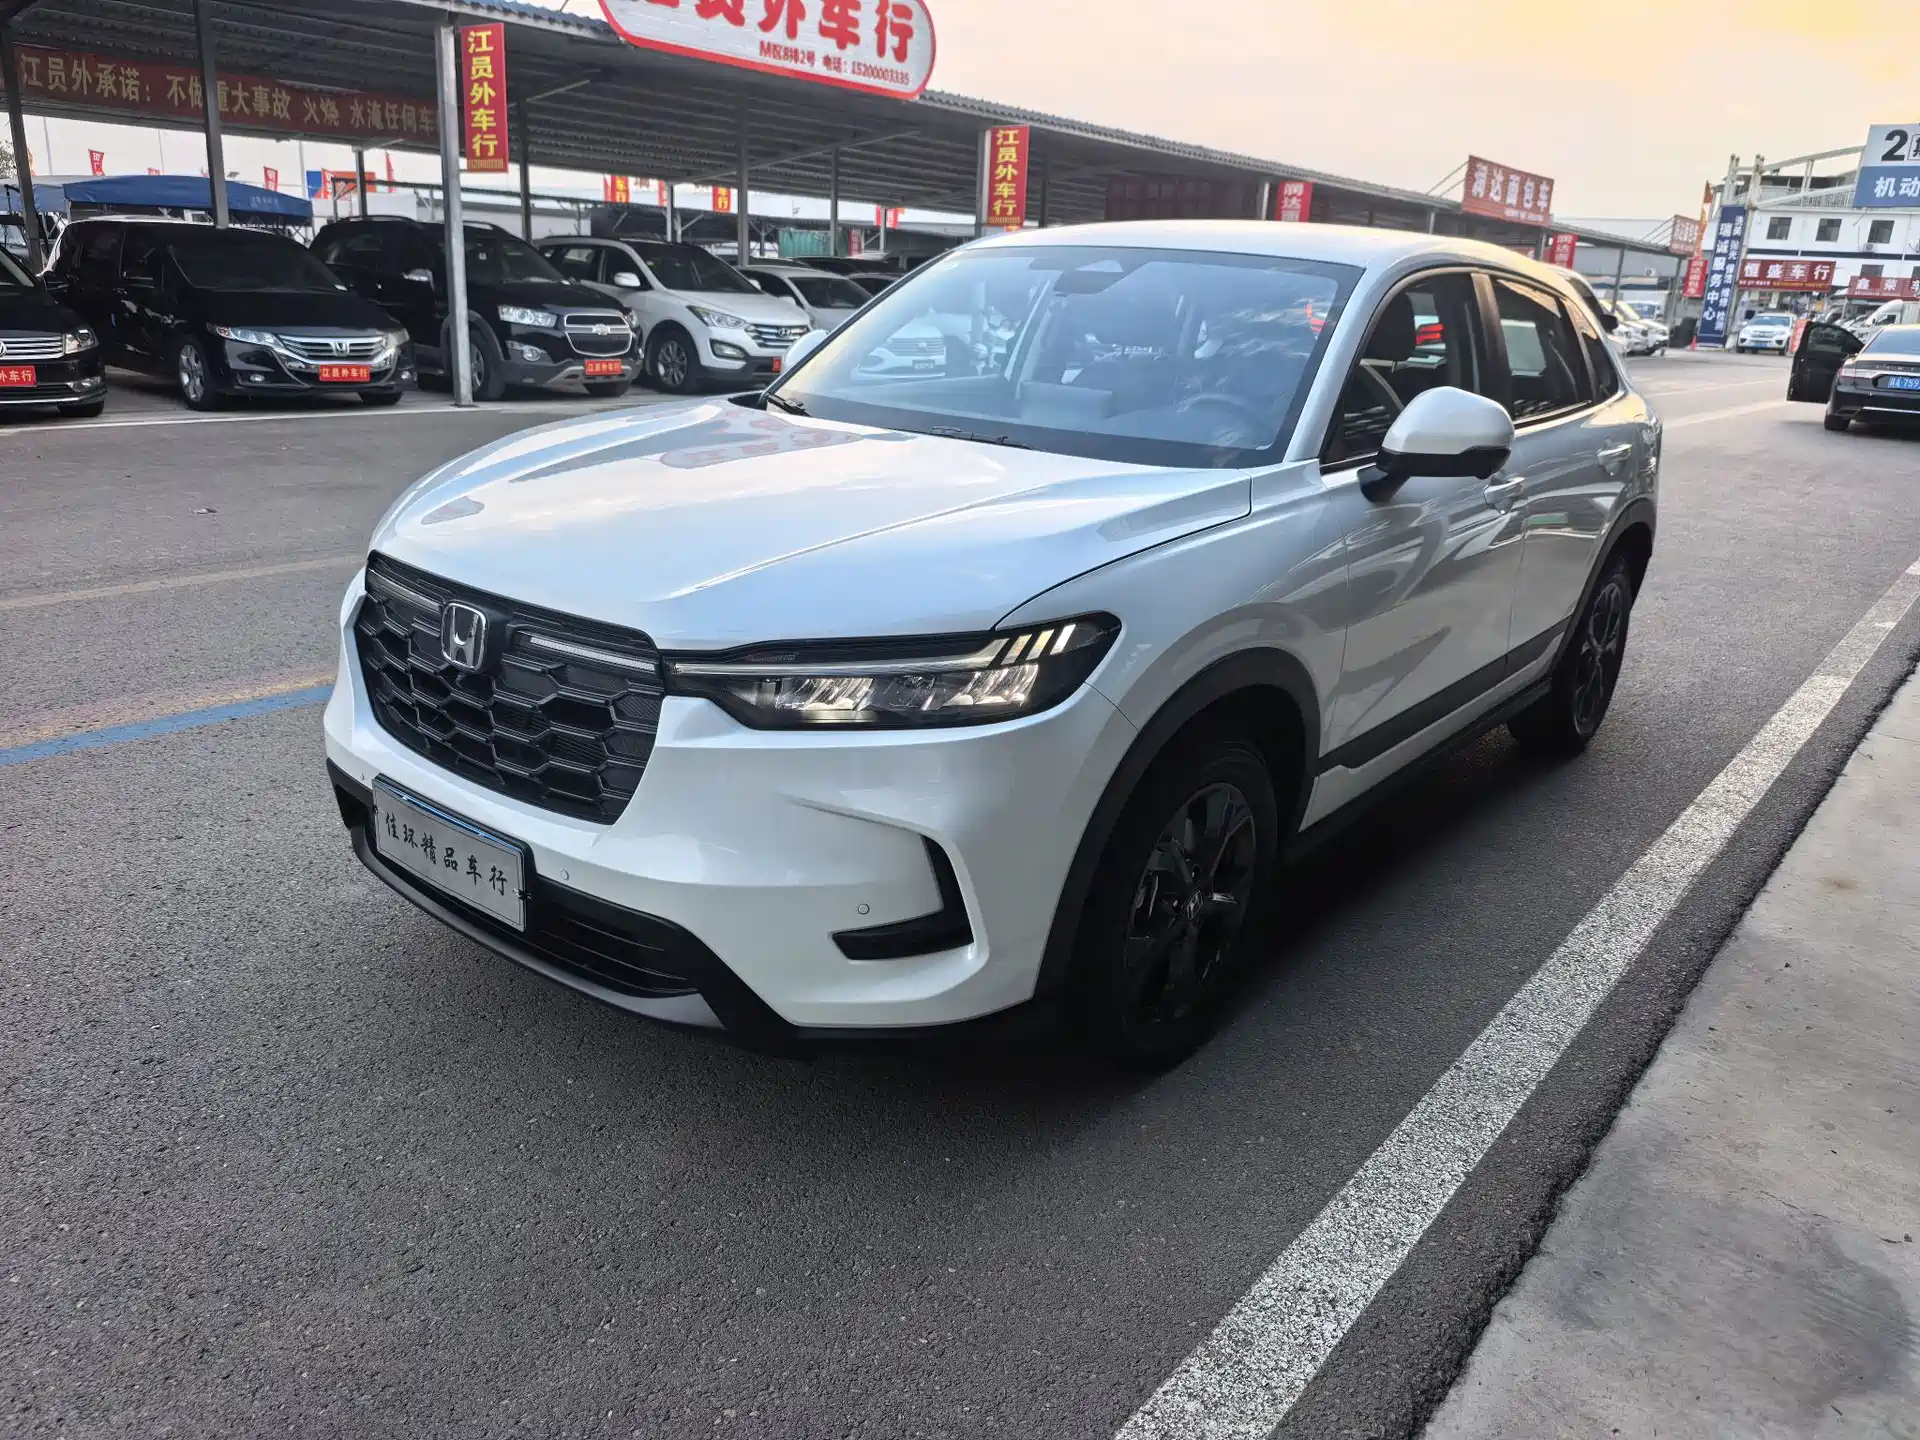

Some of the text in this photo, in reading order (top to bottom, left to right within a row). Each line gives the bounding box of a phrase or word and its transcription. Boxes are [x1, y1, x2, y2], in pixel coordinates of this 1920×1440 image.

[468, 30, 498, 157] 江员外车行
[993, 129, 1020, 216] 江员外车行
[1873, 176, 1920, 198] 机动
[1881, 129, 1909, 161] 2
[1702, 222, 1733, 321] 瑞诚服务中心
[1744, 261, 1830, 280] 恒盛车行
[385, 811, 507, 896] 佳环精品车行
